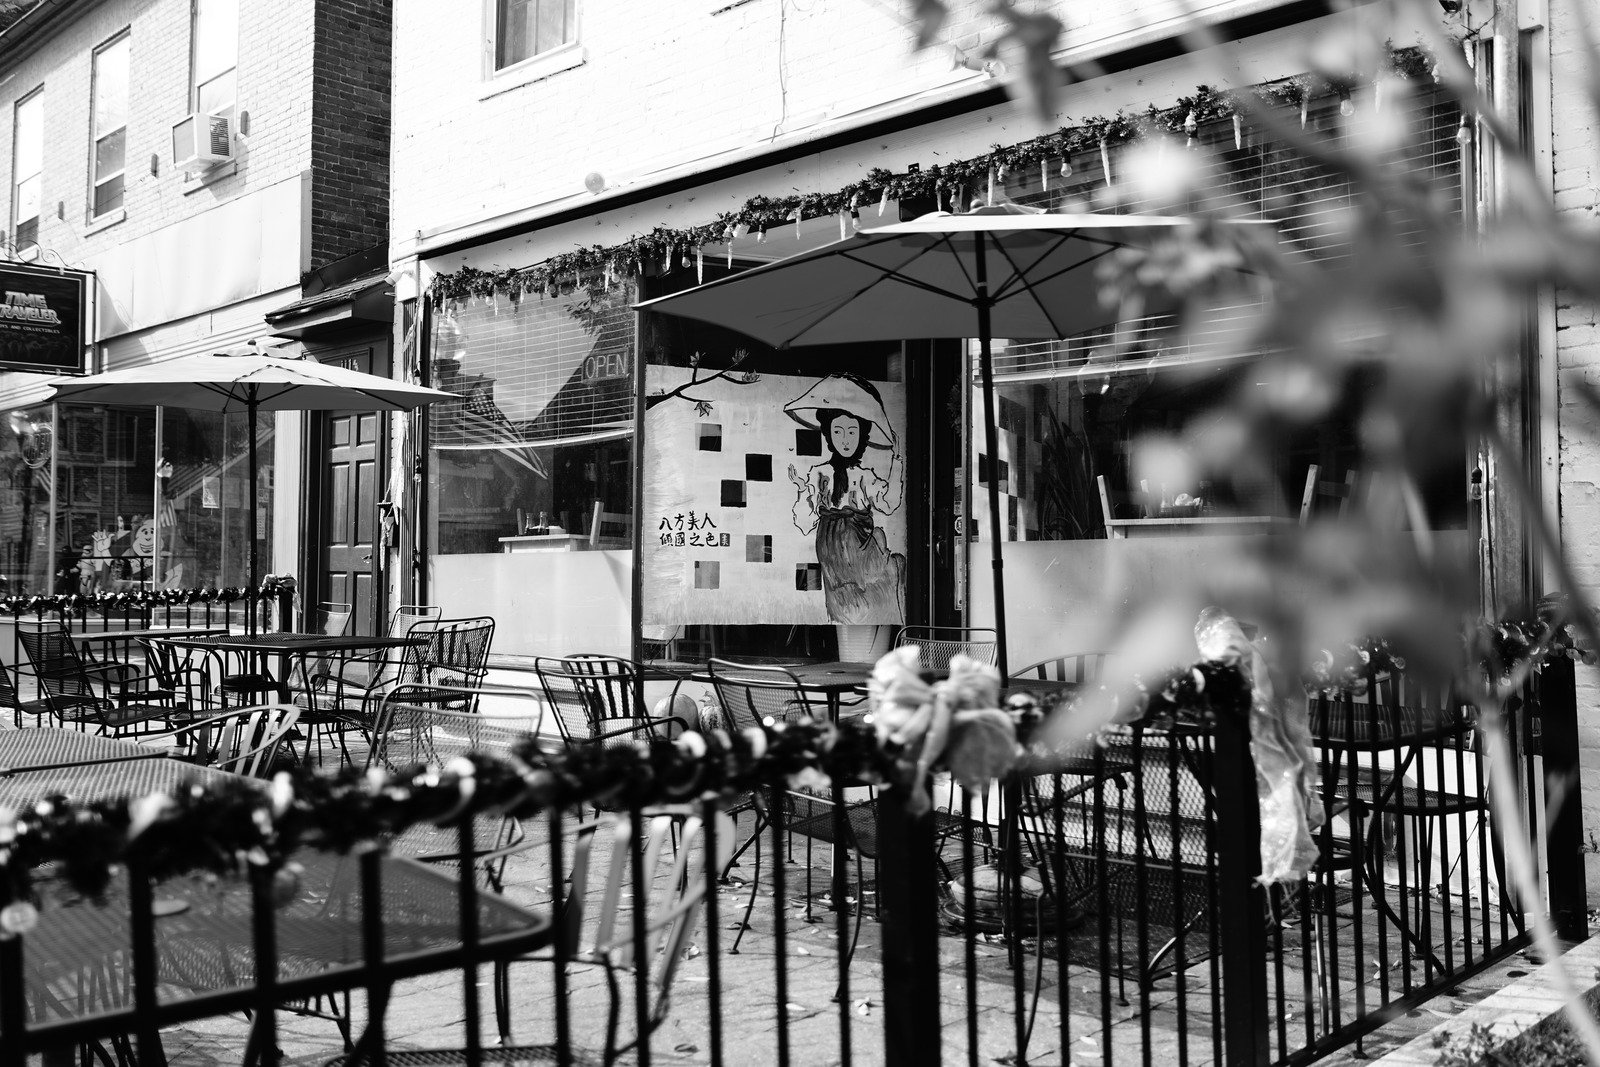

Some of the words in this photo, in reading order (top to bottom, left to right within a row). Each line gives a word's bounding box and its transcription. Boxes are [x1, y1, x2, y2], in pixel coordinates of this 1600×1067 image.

[5, 291, 48, 309] TIME
[23, 326, 60, 334] COLLECTIBLES
[586, 353, 626, 379] OPEN
[659, 510, 717, 531] 八方美人
